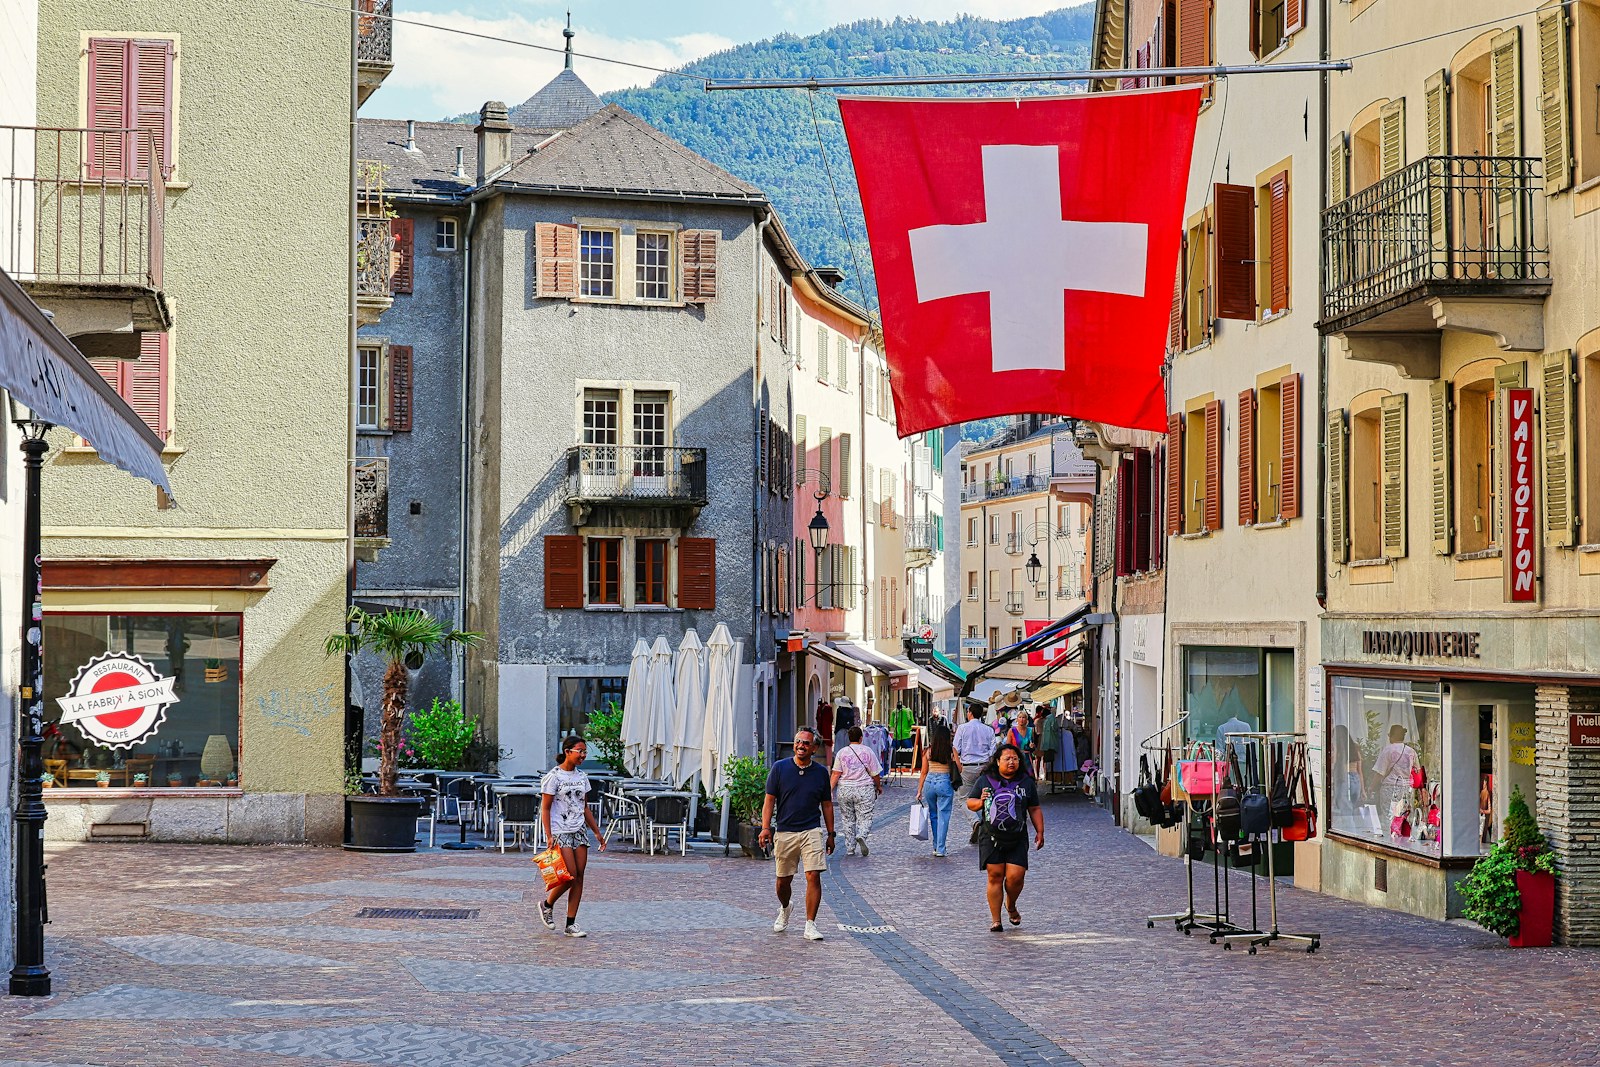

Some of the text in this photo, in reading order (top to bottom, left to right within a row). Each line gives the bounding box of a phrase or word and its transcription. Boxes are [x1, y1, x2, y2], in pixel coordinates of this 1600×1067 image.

[1513, 399, 1534, 592] VALLOTTON
[1362, 630, 1481, 660] MAROQUINERIE
[93, 663, 145, 678] RESTAURANT
[71, 703, 85, 713] LA
[128, 690, 136, 702] À
[105, 728, 130, 739] CAFÉ
